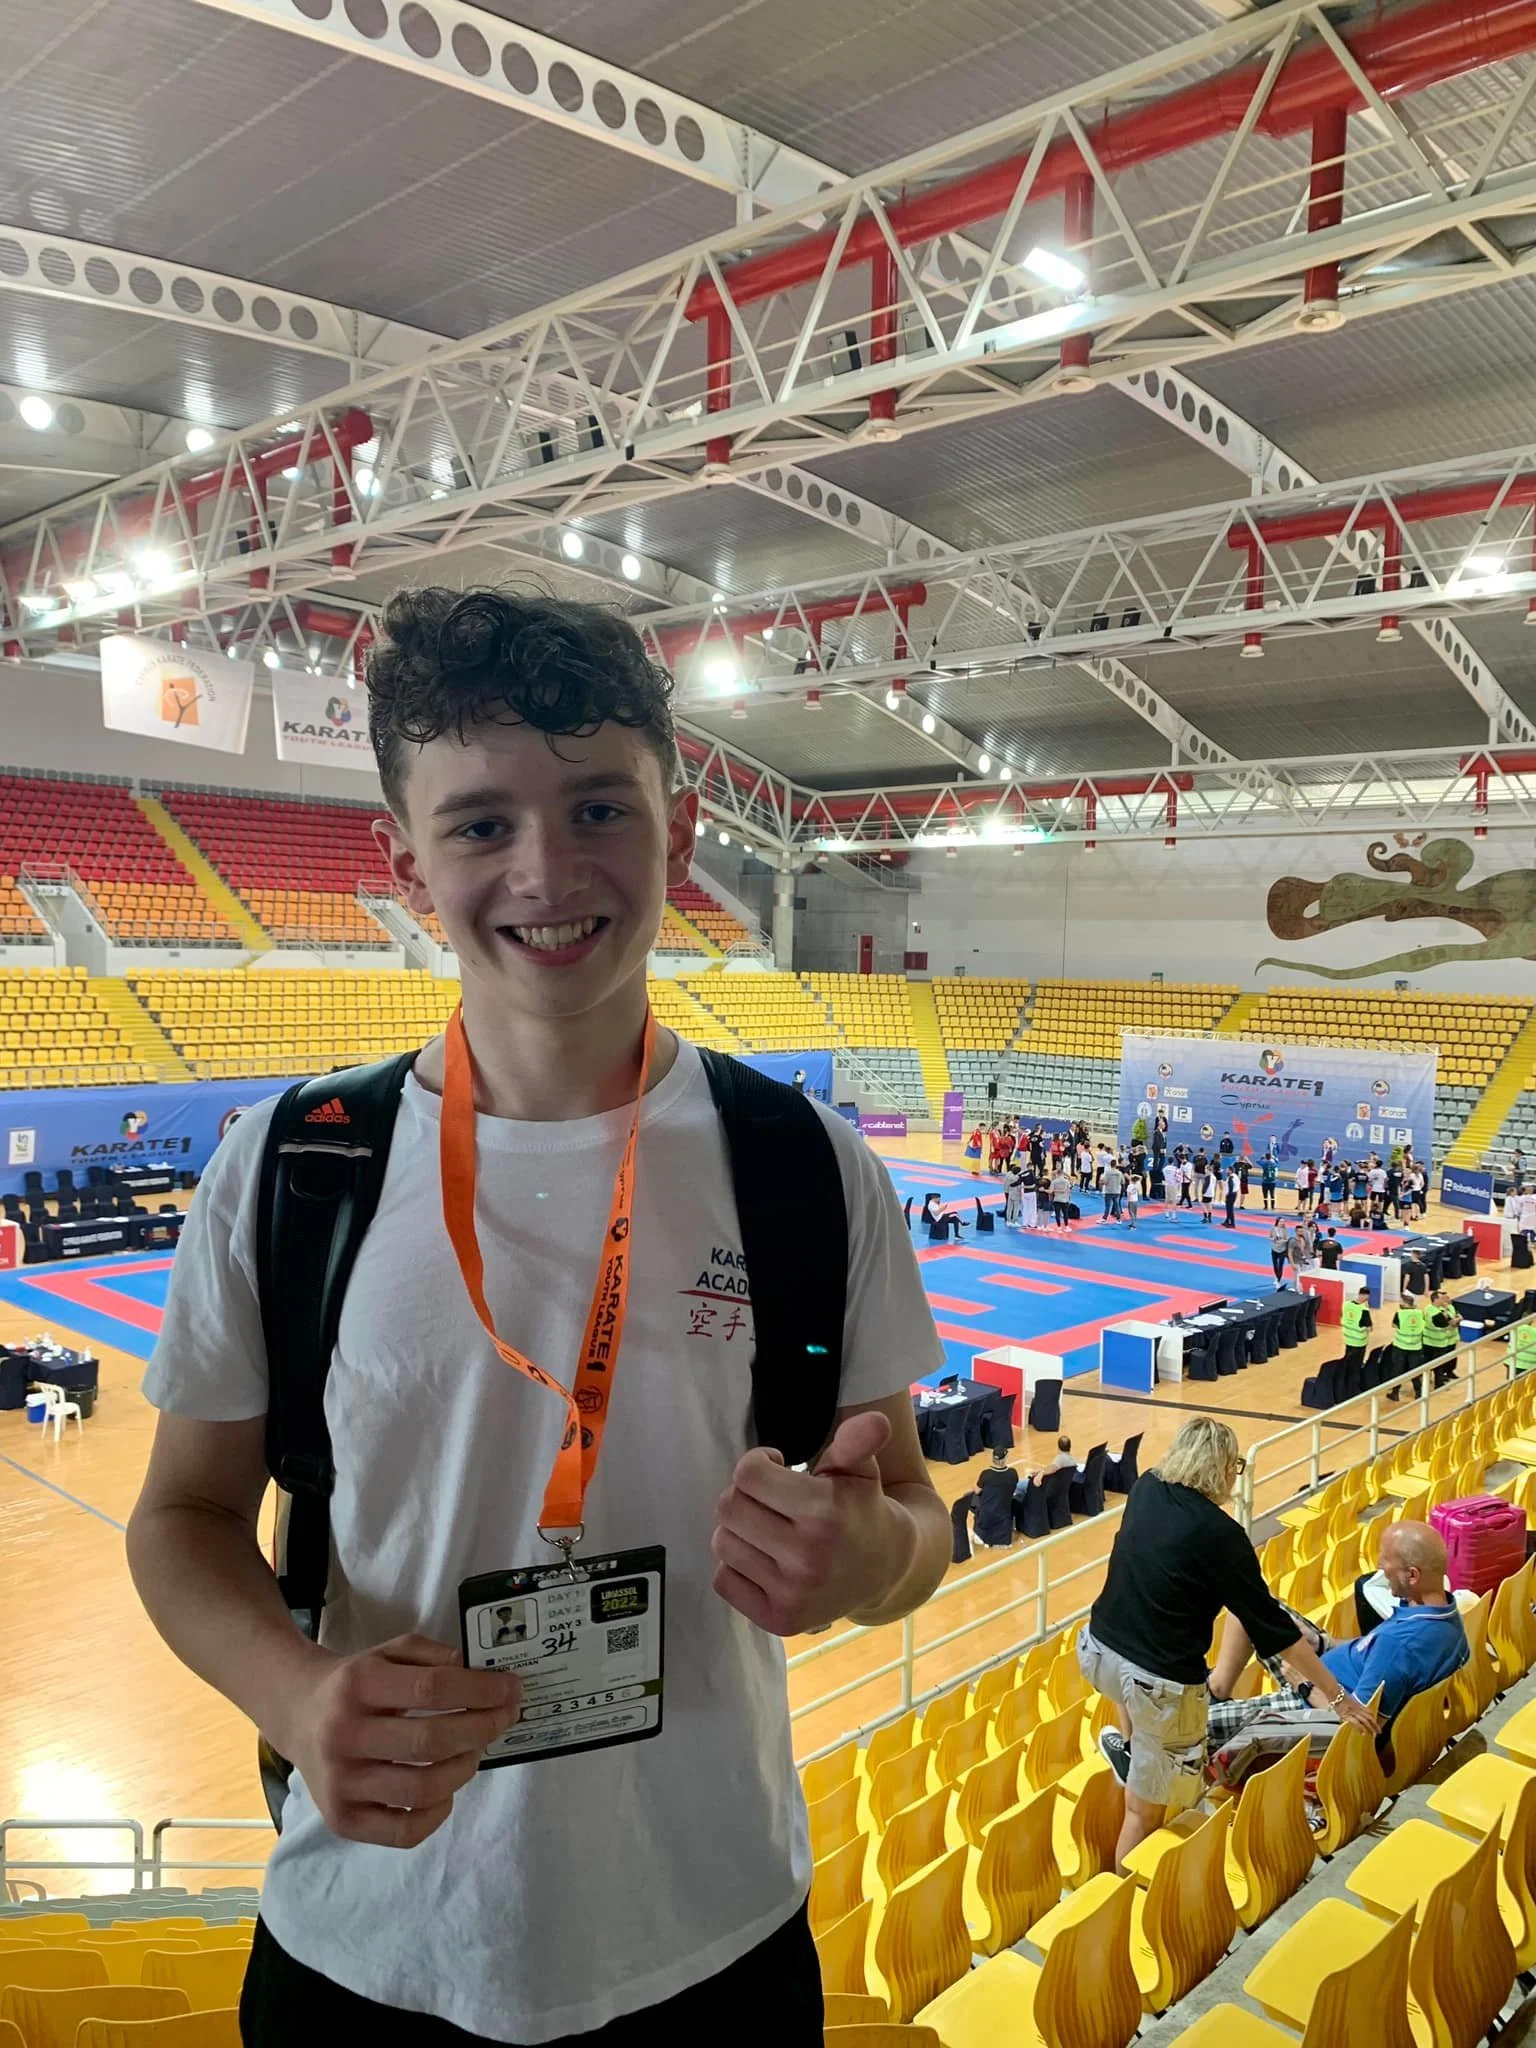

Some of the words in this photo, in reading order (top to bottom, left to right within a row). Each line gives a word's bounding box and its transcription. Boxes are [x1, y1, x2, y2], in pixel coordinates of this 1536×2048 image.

[282, 721, 371, 743] KARAT
[304, 1112, 351, 1124] adidas
[710, 1247, 747, 1272] KAR
[602, 1256, 614, 1302] YOUTH
[696, 1271, 748, 1295] ACAD
[588, 1304, 605, 1358] LEAGUE
[686, 1302, 747, 1341] 空手
[547, 1592, 574, 1604] DAY
[601, 1597, 638, 1612] 2022
[548, 1607, 574, 1619] DAY
[549, 1621, 574, 1633] DAY
[575, 1619, 582, 1627] 3
[541, 1631, 577, 1657] 34
[552, 1703, 562, 1713] 2
[570, 1700, 579, 1709] 3
[586, 1696, 596, 1706] 4
[605, 1692, 614, 1702] 5
